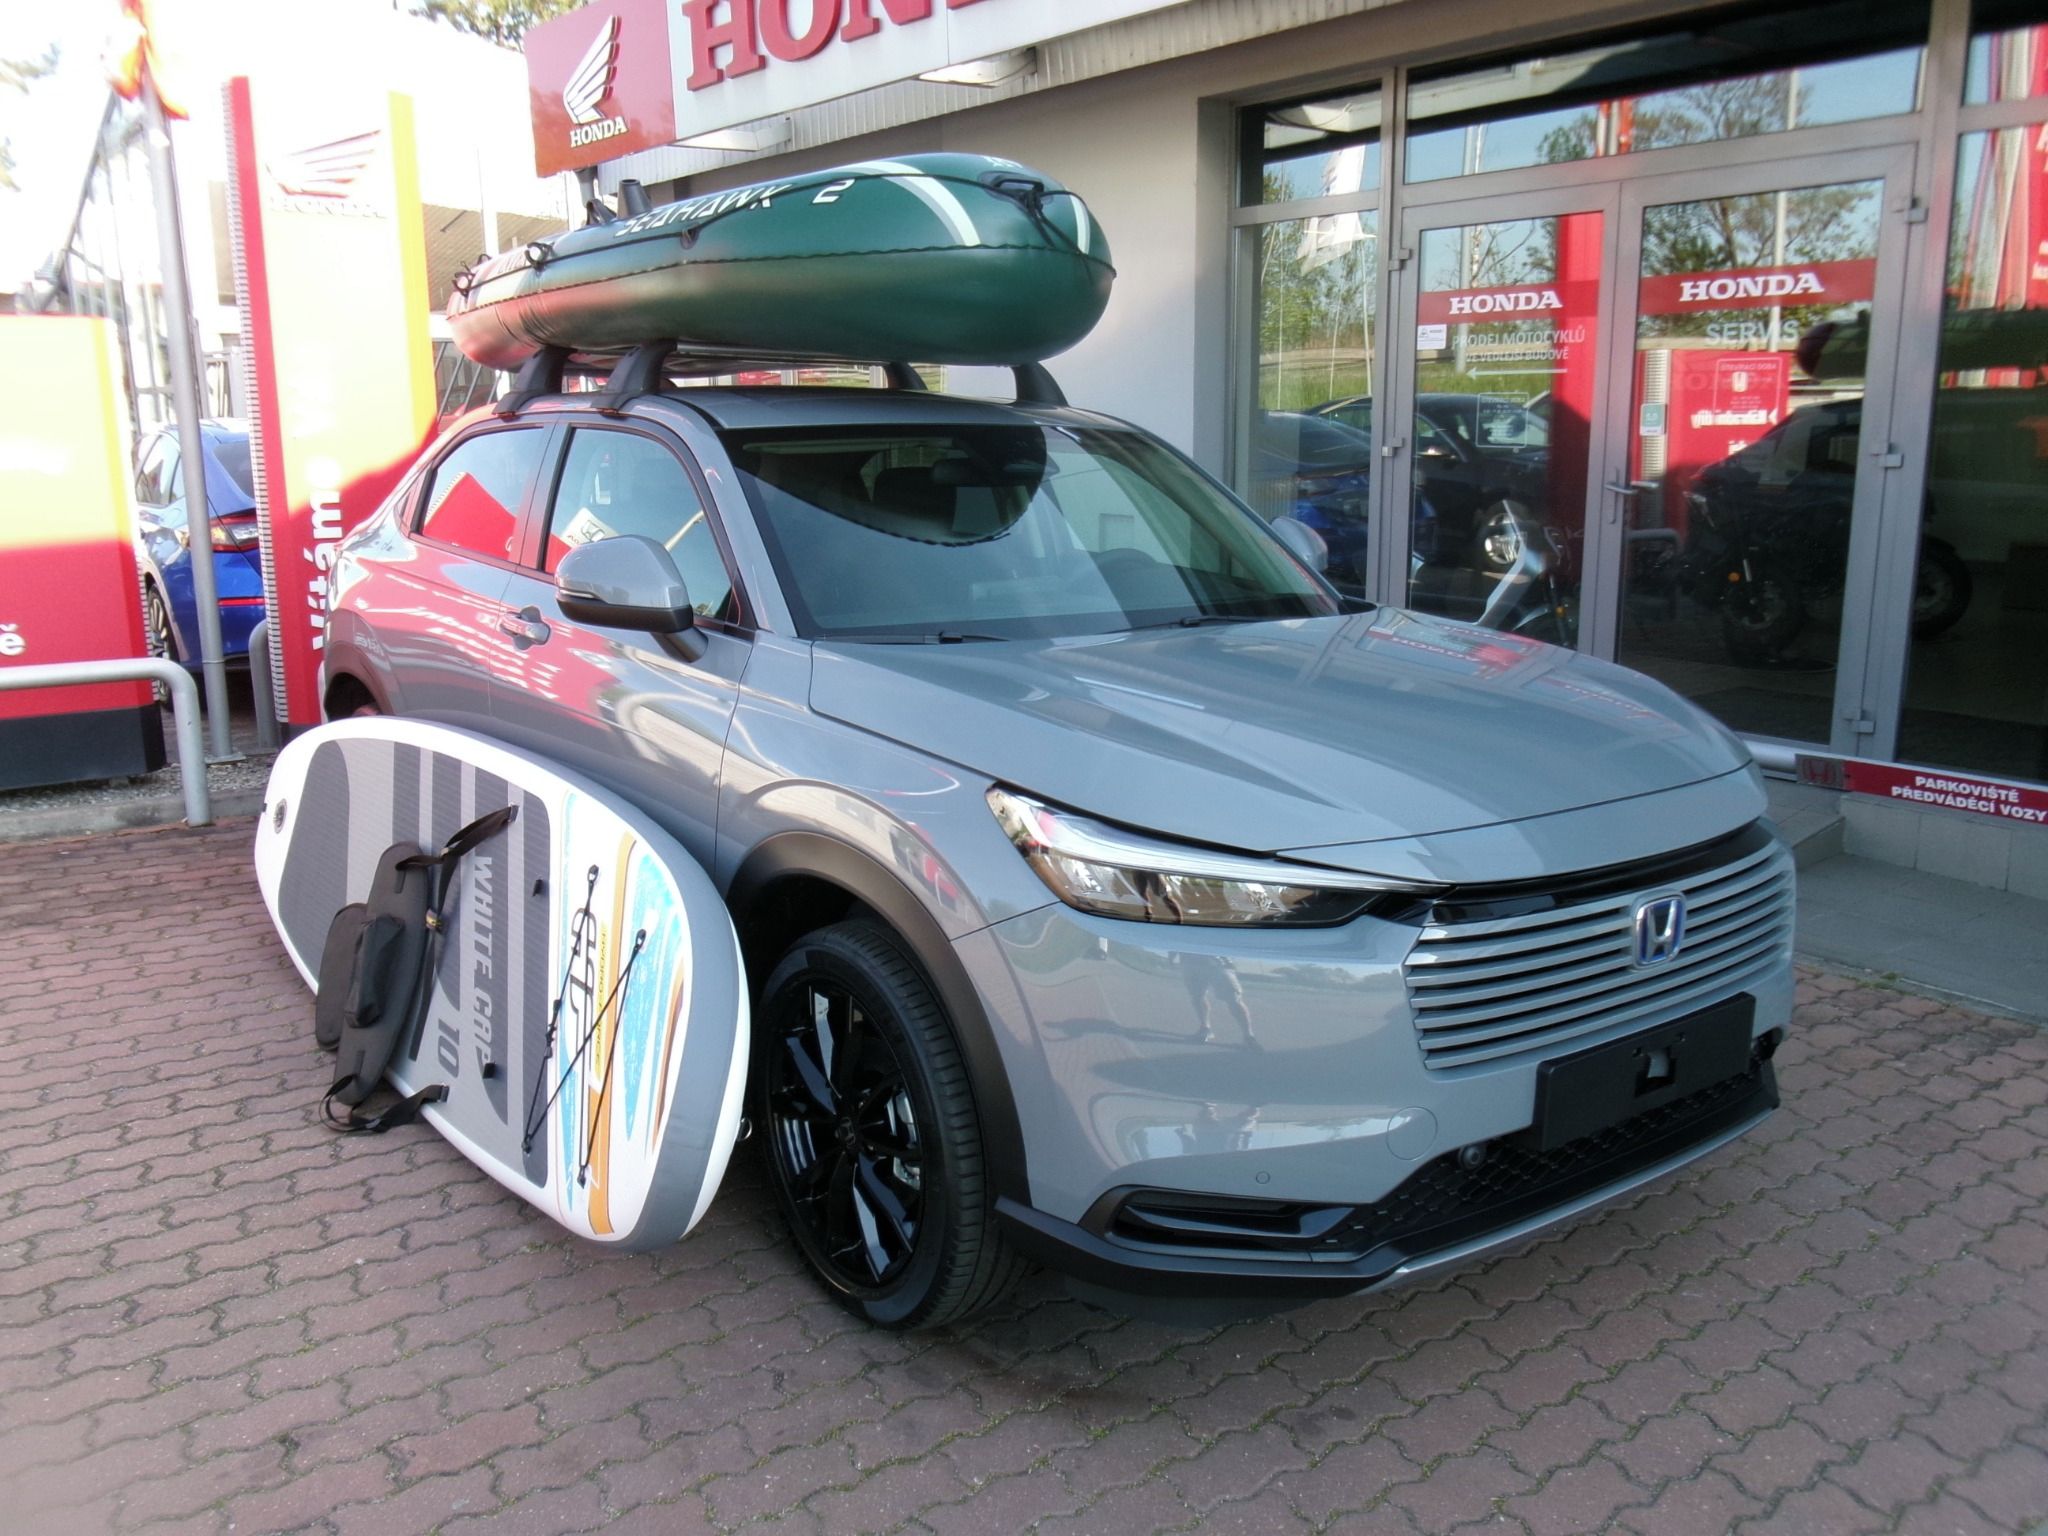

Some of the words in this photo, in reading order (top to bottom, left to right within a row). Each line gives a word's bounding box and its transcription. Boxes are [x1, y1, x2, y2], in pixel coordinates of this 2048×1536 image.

[682, 0, 990, 92] HON
[570, 116, 628, 149] HONDA
[614, 183, 793, 237] SEAHAWK
[812, 178, 856, 204] 2
[1448, 290, 1563, 315] HONDA
[1678, 272, 1825, 302] HONDA
[2000, 803, 2047, 823] VOZY
[473, 856, 493, 981] WHITE
[438, 1018, 460, 1078] 10
